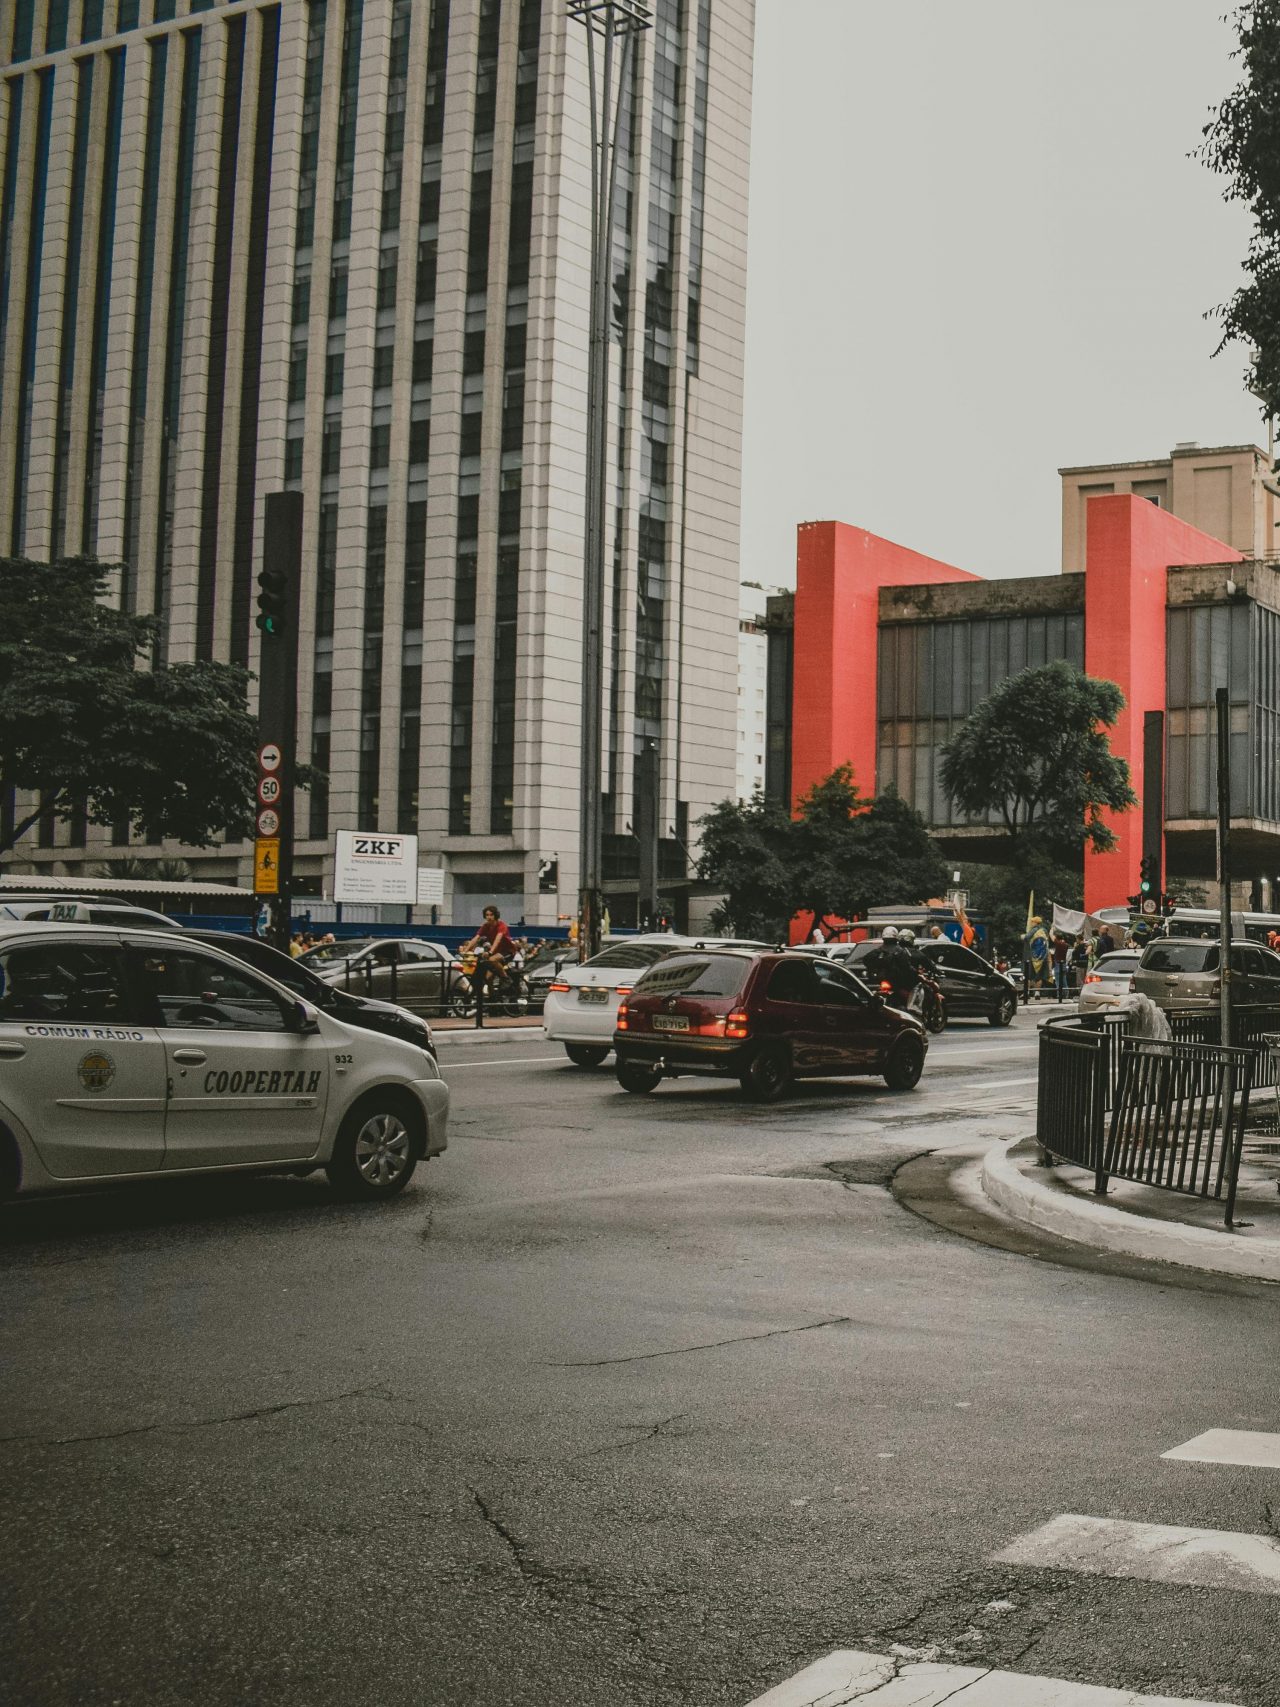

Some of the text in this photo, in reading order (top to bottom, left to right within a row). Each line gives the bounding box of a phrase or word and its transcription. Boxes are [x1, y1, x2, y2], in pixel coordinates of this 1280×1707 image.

[262, 781, 278, 795] 50
[355, 839, 400, 855] ZKF
[52, 904, 78, 920] TAXI
[25, 1025, 144, 1041] COMUM RÁDIO
[334, 1054, 354, 1064] 932
[204, 1070, 322, 1094] COOPERTAX
